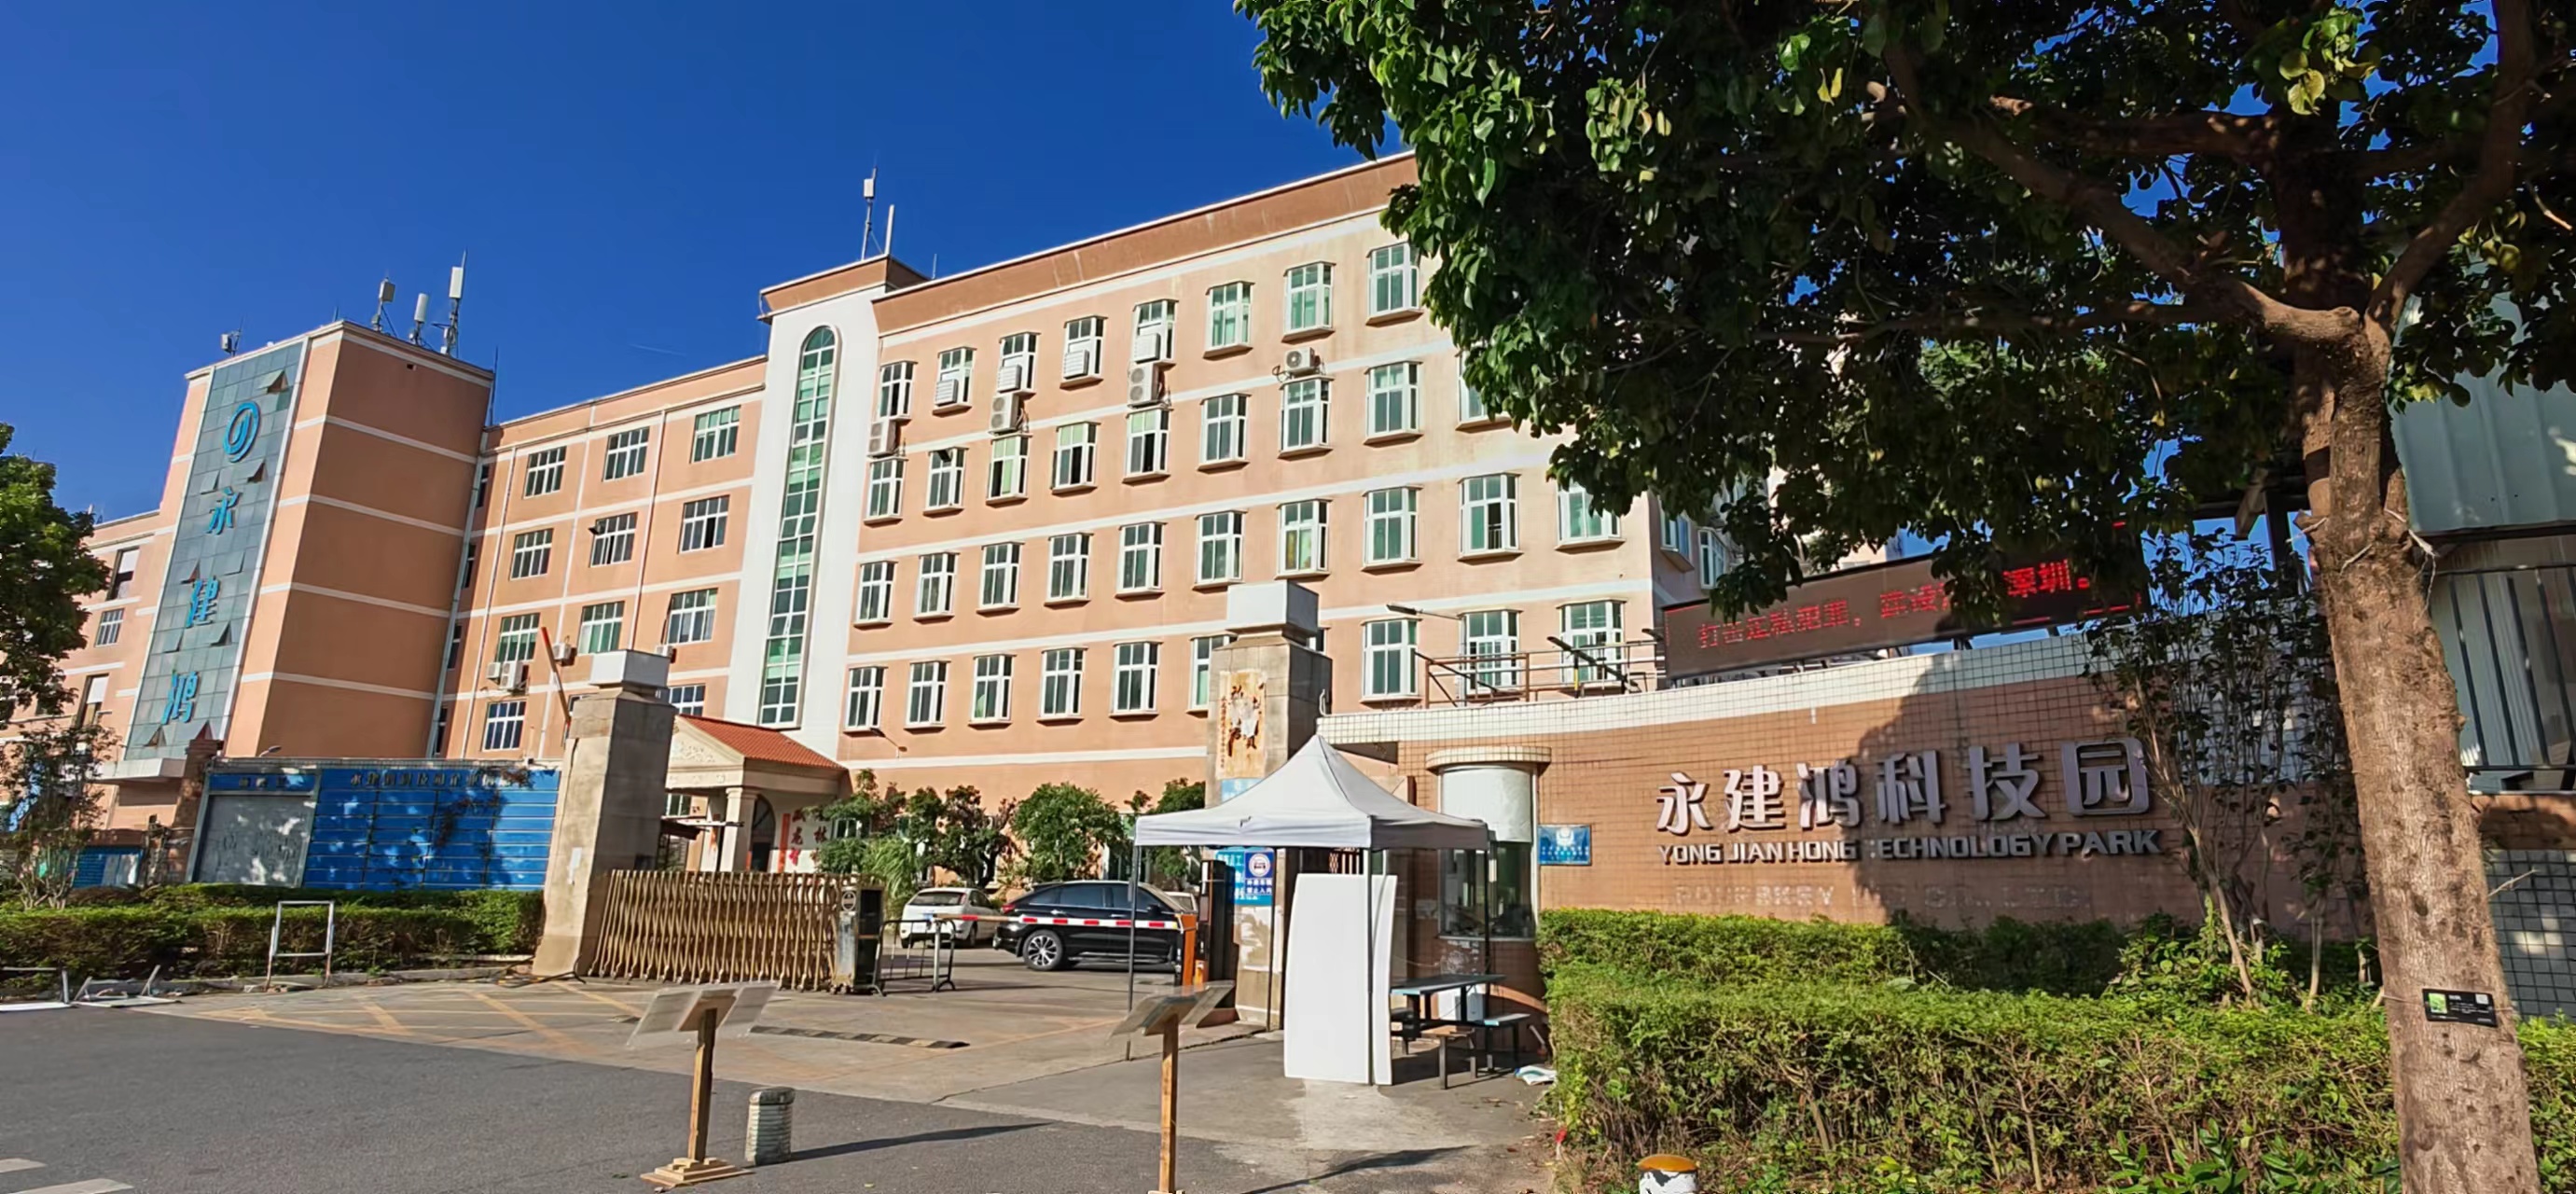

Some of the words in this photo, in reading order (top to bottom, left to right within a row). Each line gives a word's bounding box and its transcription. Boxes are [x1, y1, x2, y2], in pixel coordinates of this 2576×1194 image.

[160, 486, 243, 726] 永建鸿
[1655, 736, 2150, 837] 永建鸿科技园
[1658, 841, 1724, 866] YONG
[1725, 841, 1785, 865] JIAN
[1787, 839, 1860, 863] HONG
[1869, 831, 2053, 860] ECHNOLOGY
[2057, 829, 2163, 855] PARK
